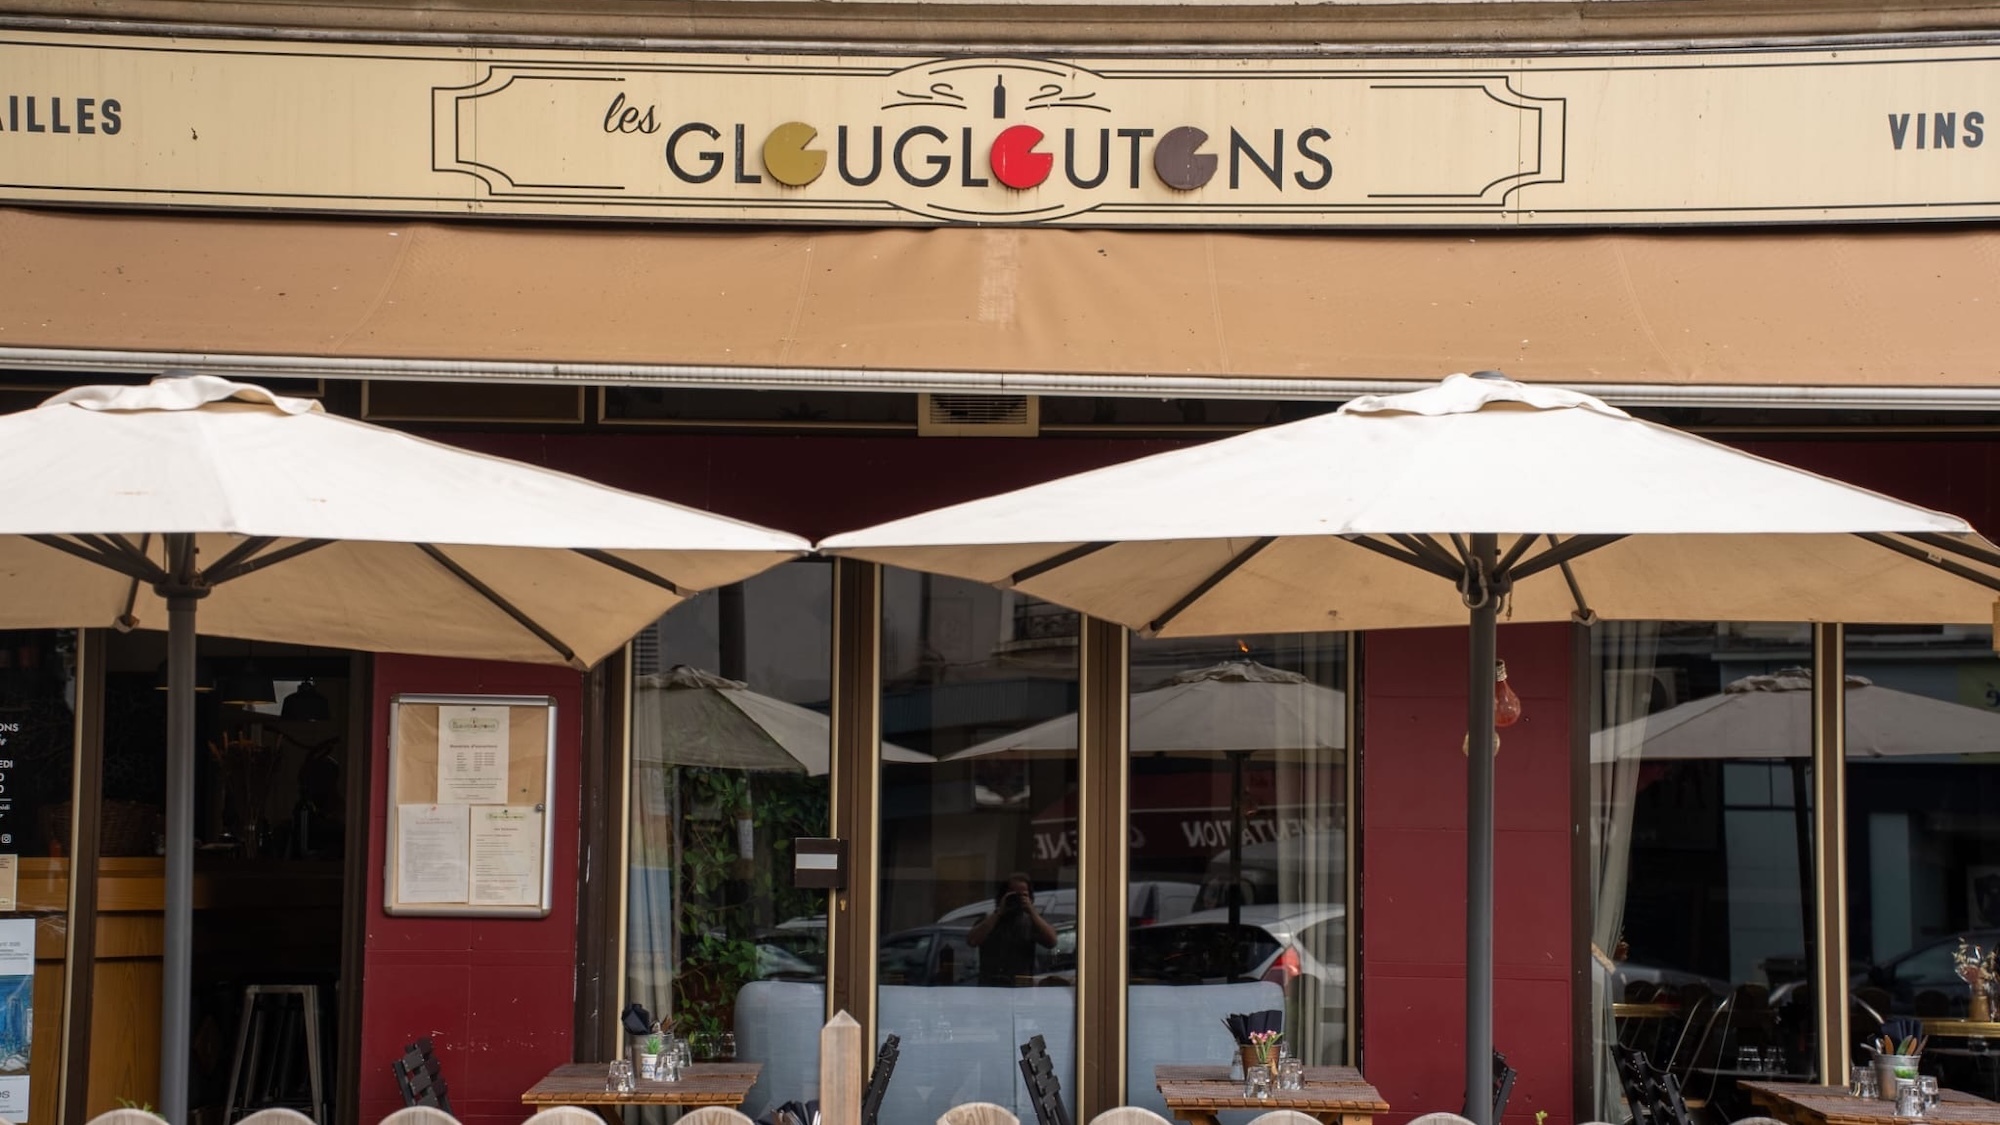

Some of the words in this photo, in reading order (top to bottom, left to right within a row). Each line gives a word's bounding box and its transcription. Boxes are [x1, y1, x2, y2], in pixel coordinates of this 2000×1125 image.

[0, 95, 122, 135] ILLES
[1888, 111, 1985, 150] VINS
[603, 91, 662, 134] les
[665, 121, 1333, 192] GLOUGLOUTONS
